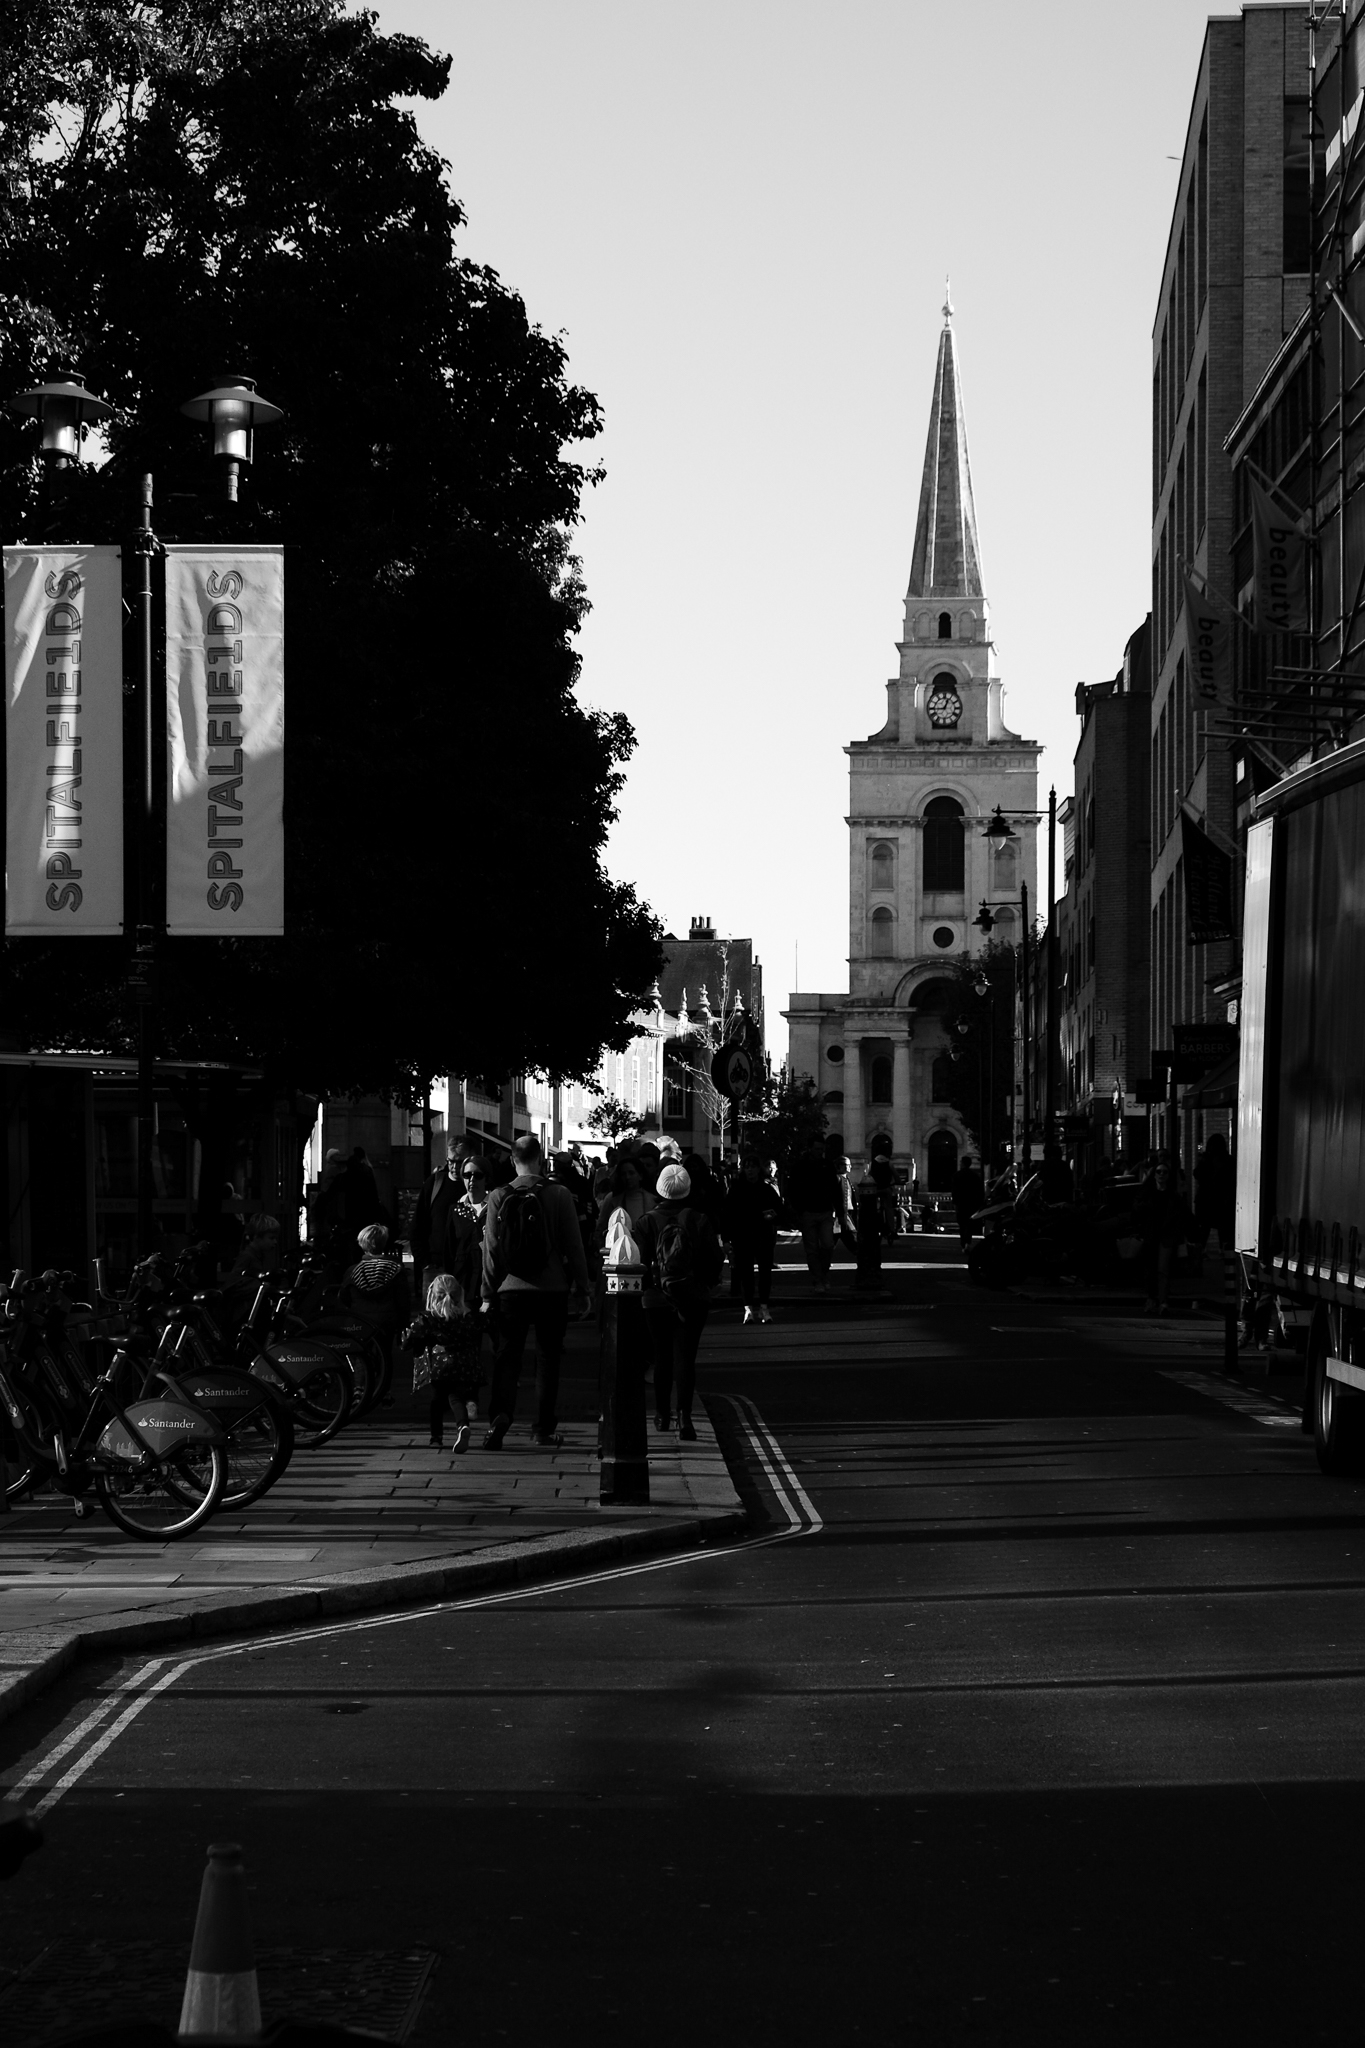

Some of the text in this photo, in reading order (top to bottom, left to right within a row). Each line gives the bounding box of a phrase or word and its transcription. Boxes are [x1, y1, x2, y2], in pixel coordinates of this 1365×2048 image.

[1266, 527, 1294, 628] beauty
[1198, 617, 1220, 702] beauty
[1207, 854, 1226, 927] Holland
[1180, 1043, 1231, 1054] BARBERS
[286, 1354, 325, 1363] Santander
[204, 1386, 250, 1397] Santander
[148, 1417, 196, 1430] Santander
